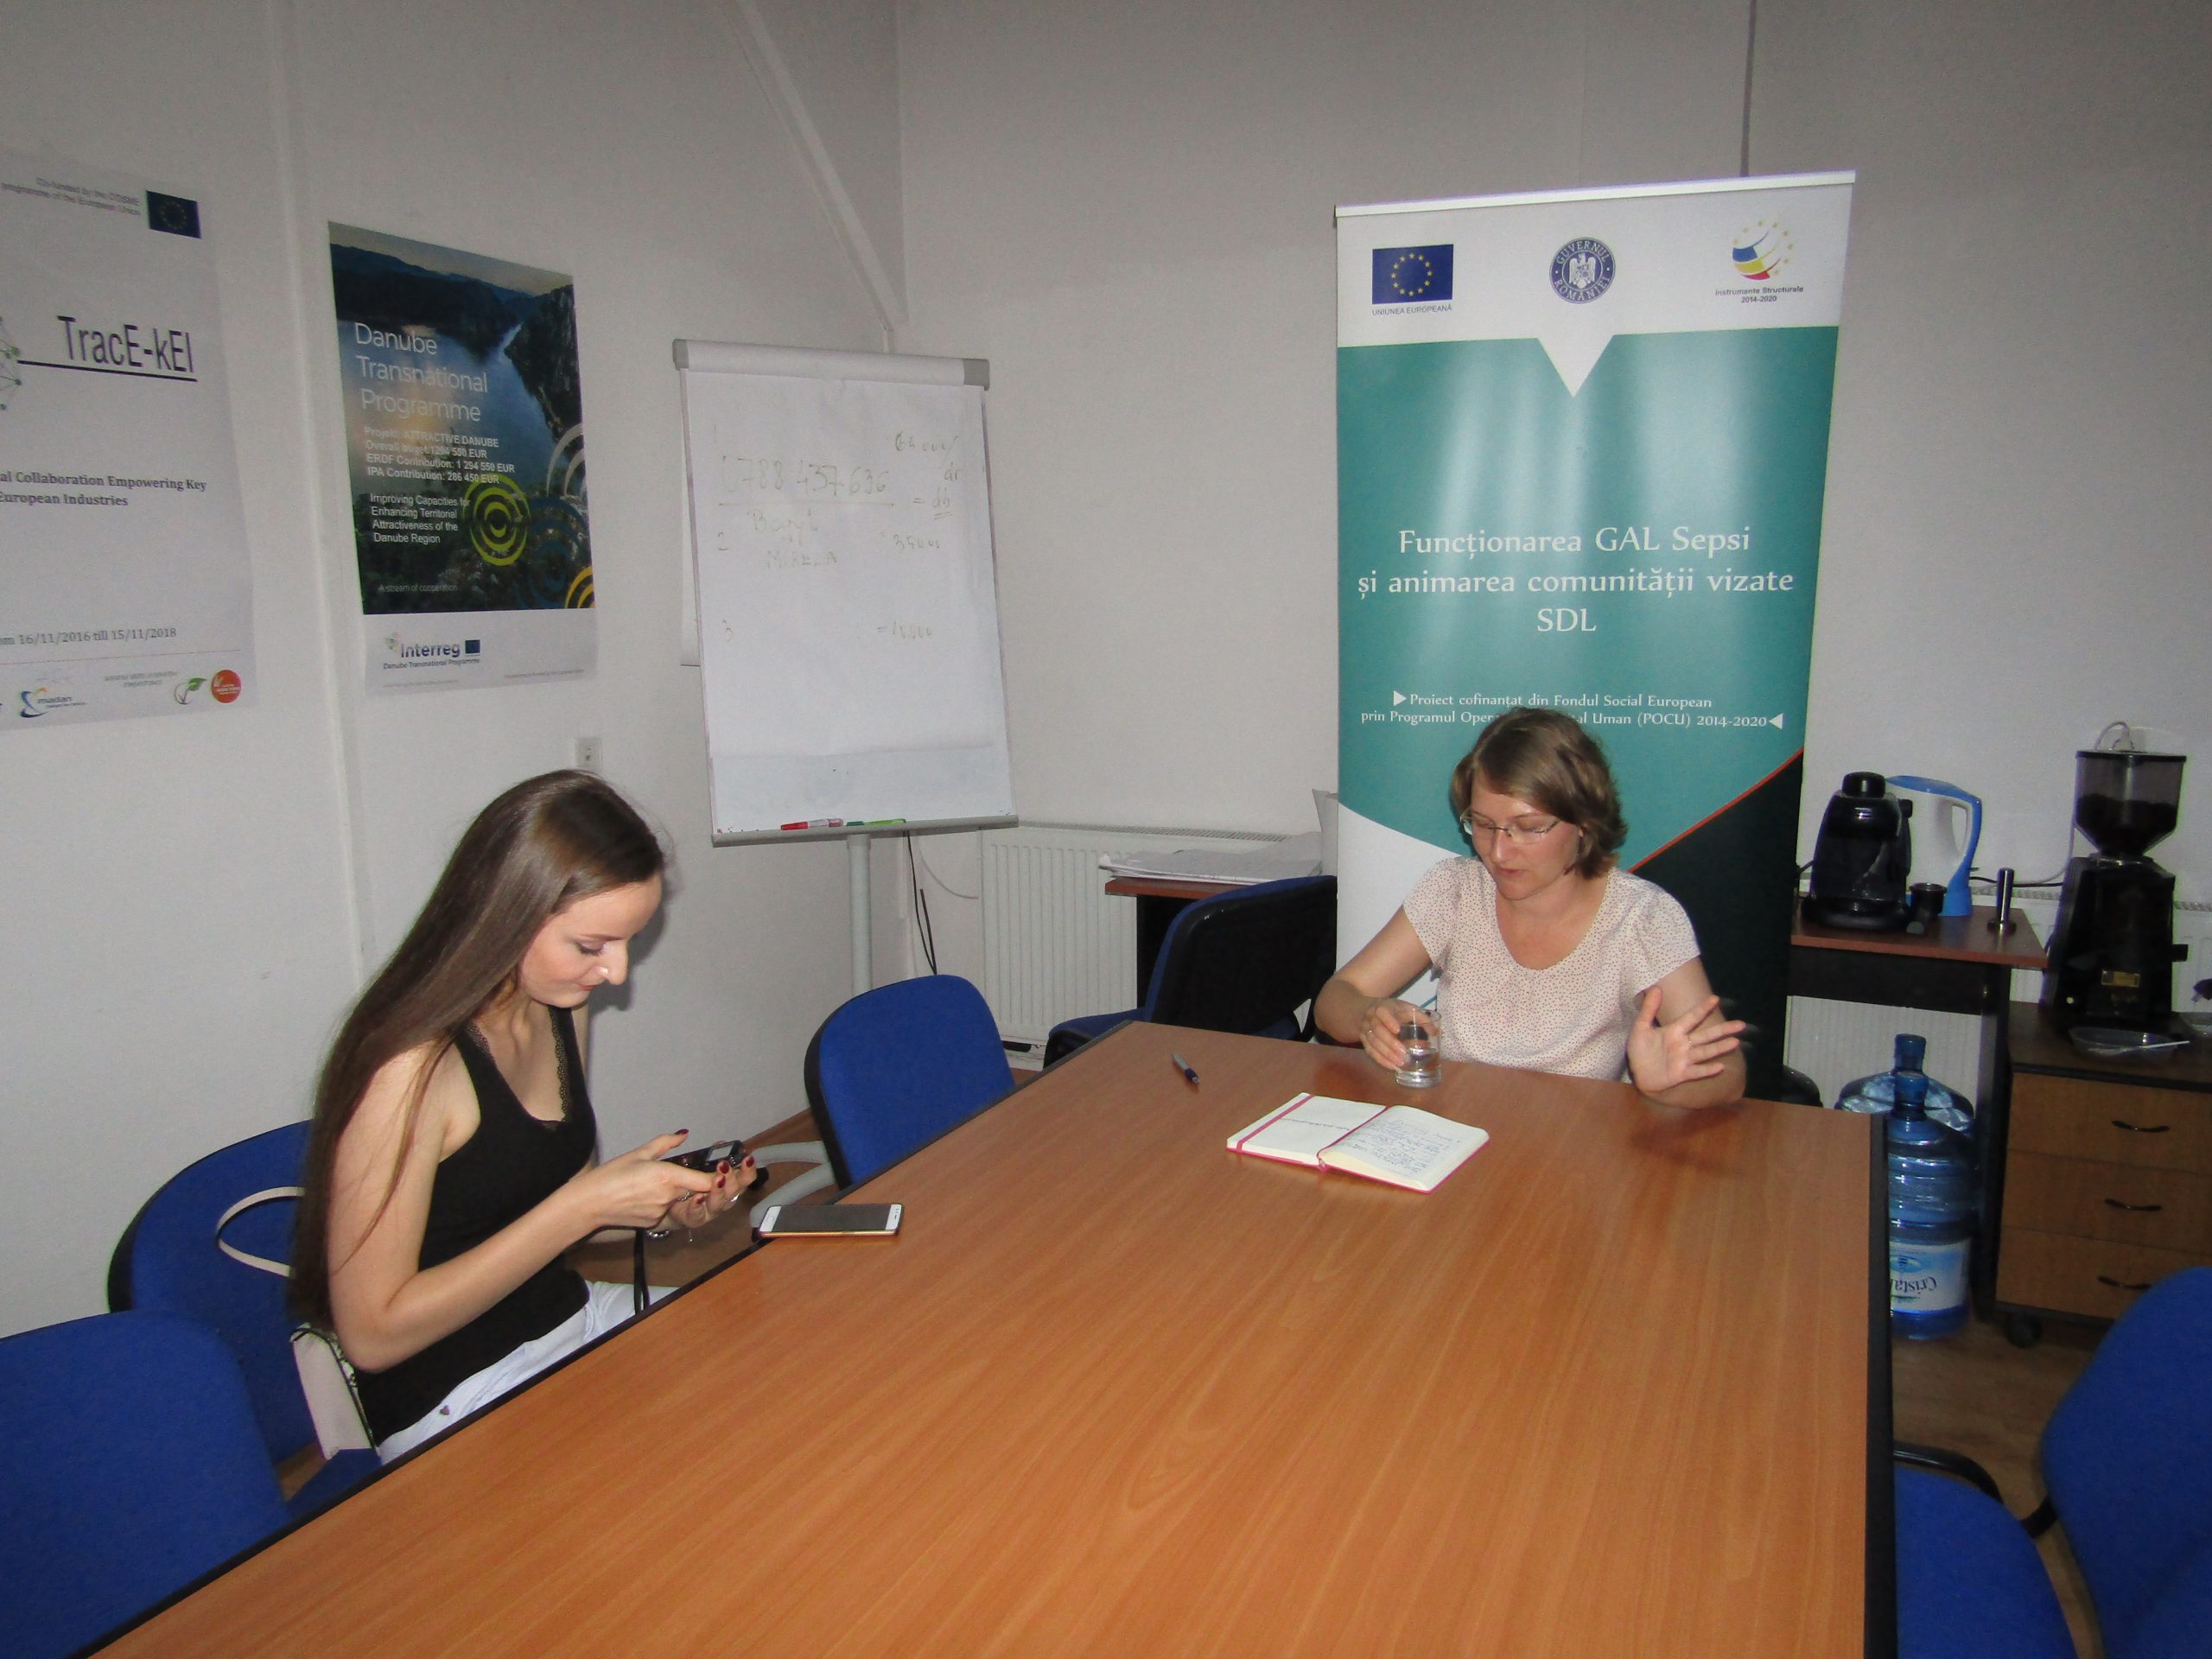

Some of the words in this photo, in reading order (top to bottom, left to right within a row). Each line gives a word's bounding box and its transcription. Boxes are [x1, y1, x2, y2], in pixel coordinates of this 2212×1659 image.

[1556, 240, 1610, 264] GUVERNUL
[1372, 308, 1404, 316] UNIUNEA
[354, 322, 437, 355] Danube
[355, 354, 488, 393] Transnational
[361, 388, 481, 422] Programme
[461, 435, 499, 448] DANUBE
[468, 448, 488, 460] EUR
[365, 454, 395, 465] ERDF
[397, 455, 454, 469] Contribution:
[464, 461, 479, 471] 294
[480, 462, 495, 472] 550
[497, 463, 516, 474] EUR
[0, 471, 12, 482] al
[16, 472, 104, 486] Collaboration
[107, 475, 184, 492] Empowering
[186, 479, 207, 492] Key
[366, 467, 385, 477] IPA
[480, 474, 500, 484] EUR
[63, 493, 129, 506] Industries
[370, 493, 414, 506] Improving
[416, 495, 458, 506] Capacities
[371, 506, 418, 519] Enhancing
[420, 508, 458, 518] Territorial
[372, 519, 434, 531] Attractiveness
[435, 521, 444, 531] of
[445, 522, 459, 531] the
[373, 532, 410, 543] Danube
[410, 533, 441, 545] Region
[1398, 529, 1581, 560] Funcționarea
[1595, 525, 1660, 551] GAL
[1672, 525, 1750, 559] Sepsi
[1357, 569, 1377, 600] și
[1388, 569, 1515, 593] animarea
[1527, 567, 1694, 599] comunității
[1706, 568, 1794, 592] vizate
[1536, 607, 1597, 632] SDL
[18, 632, 92, 646] 16/11/2016
[92, 631, 109, 641] till
[111, 628, 177, 641] 15/11/2018
[400, 643, 461, 658] Interreg
[409, 659, 448, 668] Transnational
[448, 658, 480, 667] Programme
[1410, 693, 1453, 706] Proiect
[1528, 693, 1548, 706] din
[1554, 693, 1599, 707] Fondul
[1603, 694, 1643, 707] Social
[1647, 695, 1713, 711] European
[1361, 709, 1385, 724] prin
[1389, 710, 1455, 726] Programul
[1592, 713, 1631, 725] Uman
[1637, 712, 1691, 728] (POCU)
[1696, 714, 1767, 728] 2014-2020
